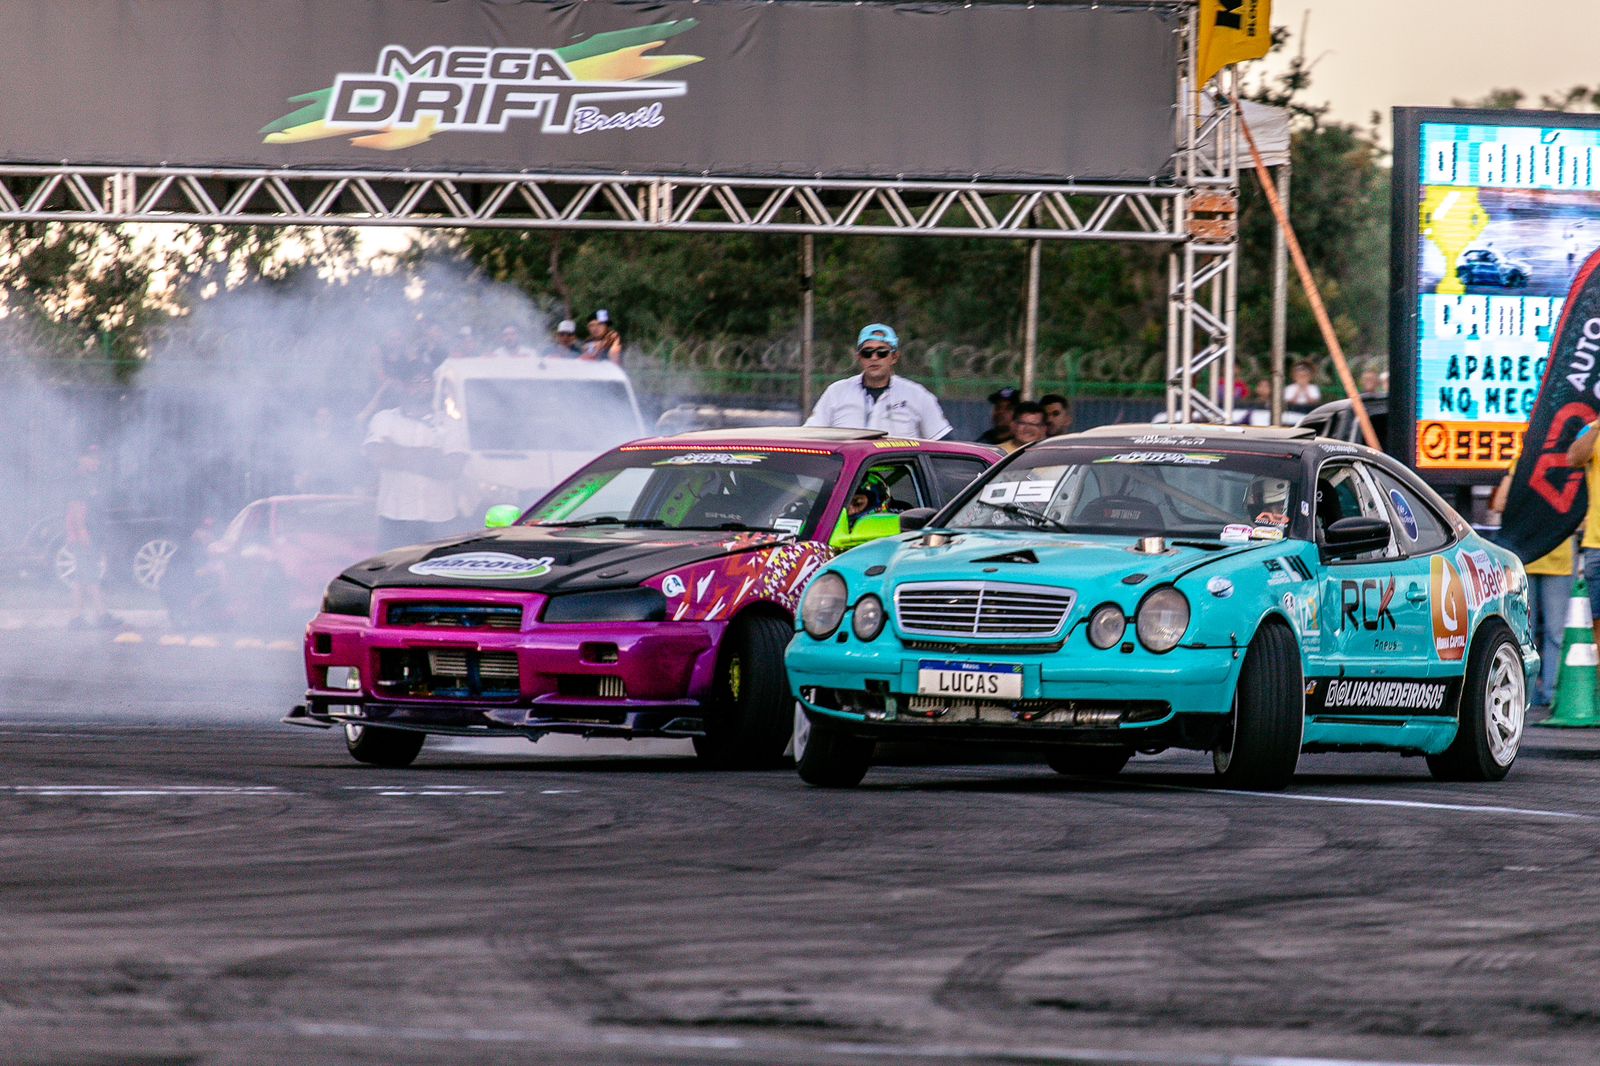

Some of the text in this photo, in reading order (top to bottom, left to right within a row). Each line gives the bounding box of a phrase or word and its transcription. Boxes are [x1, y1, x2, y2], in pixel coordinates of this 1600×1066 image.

[381, 47, 574, 81] MEGA
[328, 78, 686, 132] DRIFT
[575, 102, 665, 134] Brasil
[1566, 317, 1600, 392] AUTO
[1439, 386, 1472, 413] NO
[1341, 573, 1396, 632] RCK
[939, 672, 999, 694] LUCAS
[1336, 680, 1447, 709] @LUCASMEDEIROS05
